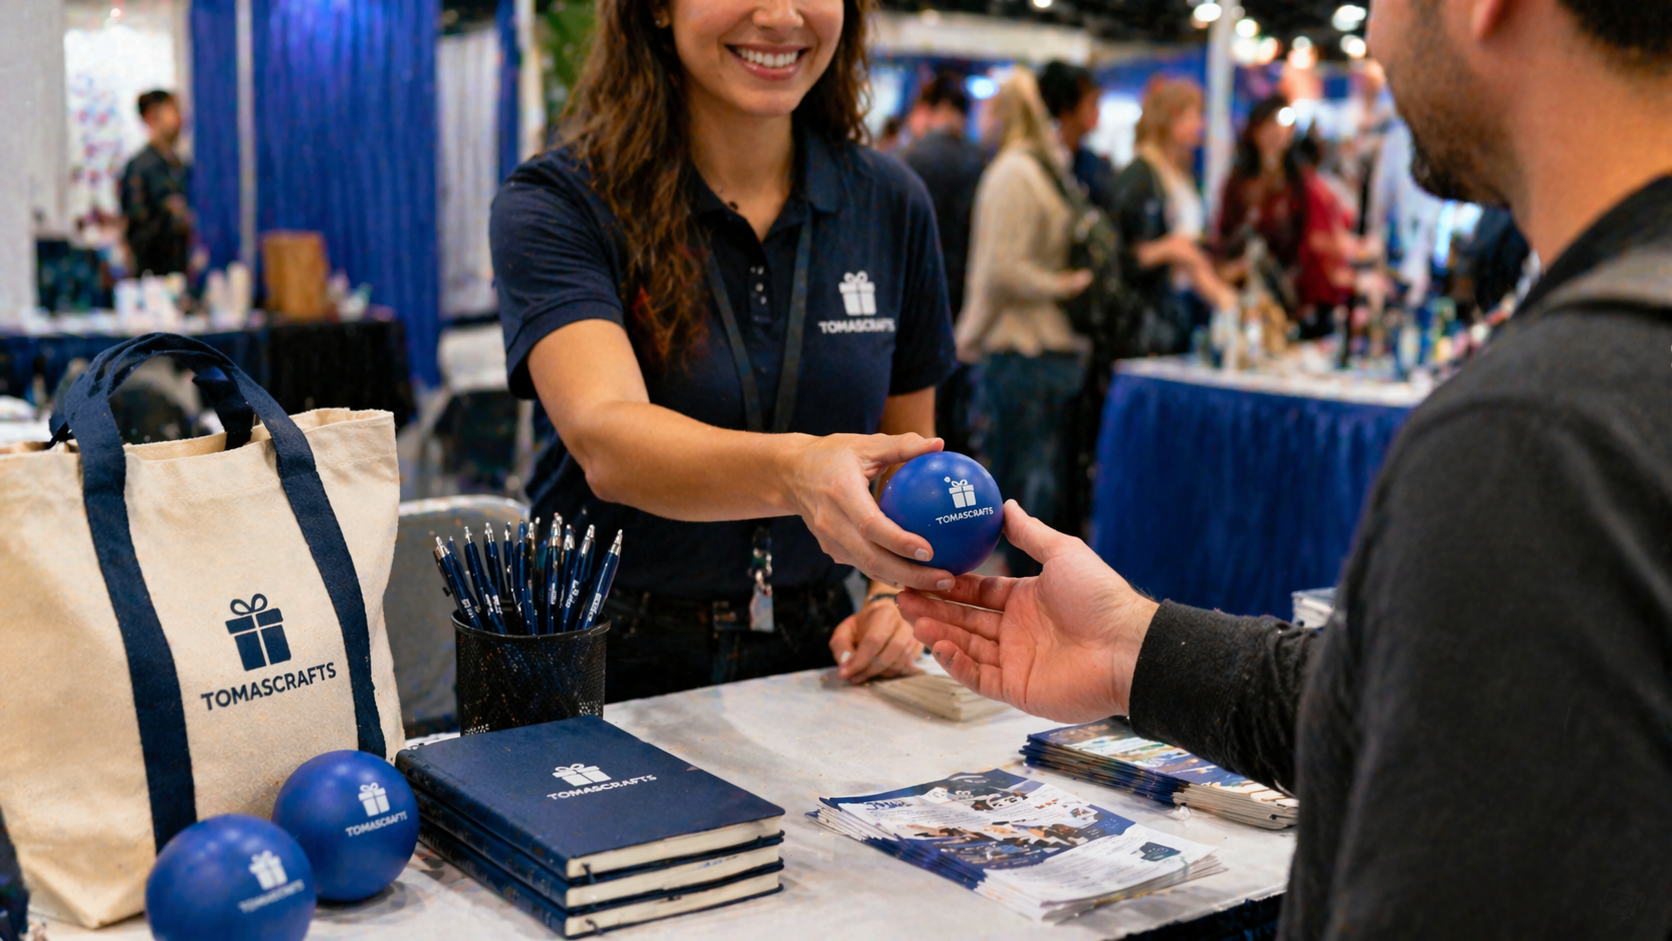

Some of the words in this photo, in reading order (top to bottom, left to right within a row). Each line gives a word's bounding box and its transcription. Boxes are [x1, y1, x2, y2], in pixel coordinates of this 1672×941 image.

[934, 506, 994, 525] TOMASCRAFTS
[200, 661, 337, 711] TOMASCRAFTS
[546, 774, 658, 800] TOMASCRAFTS
